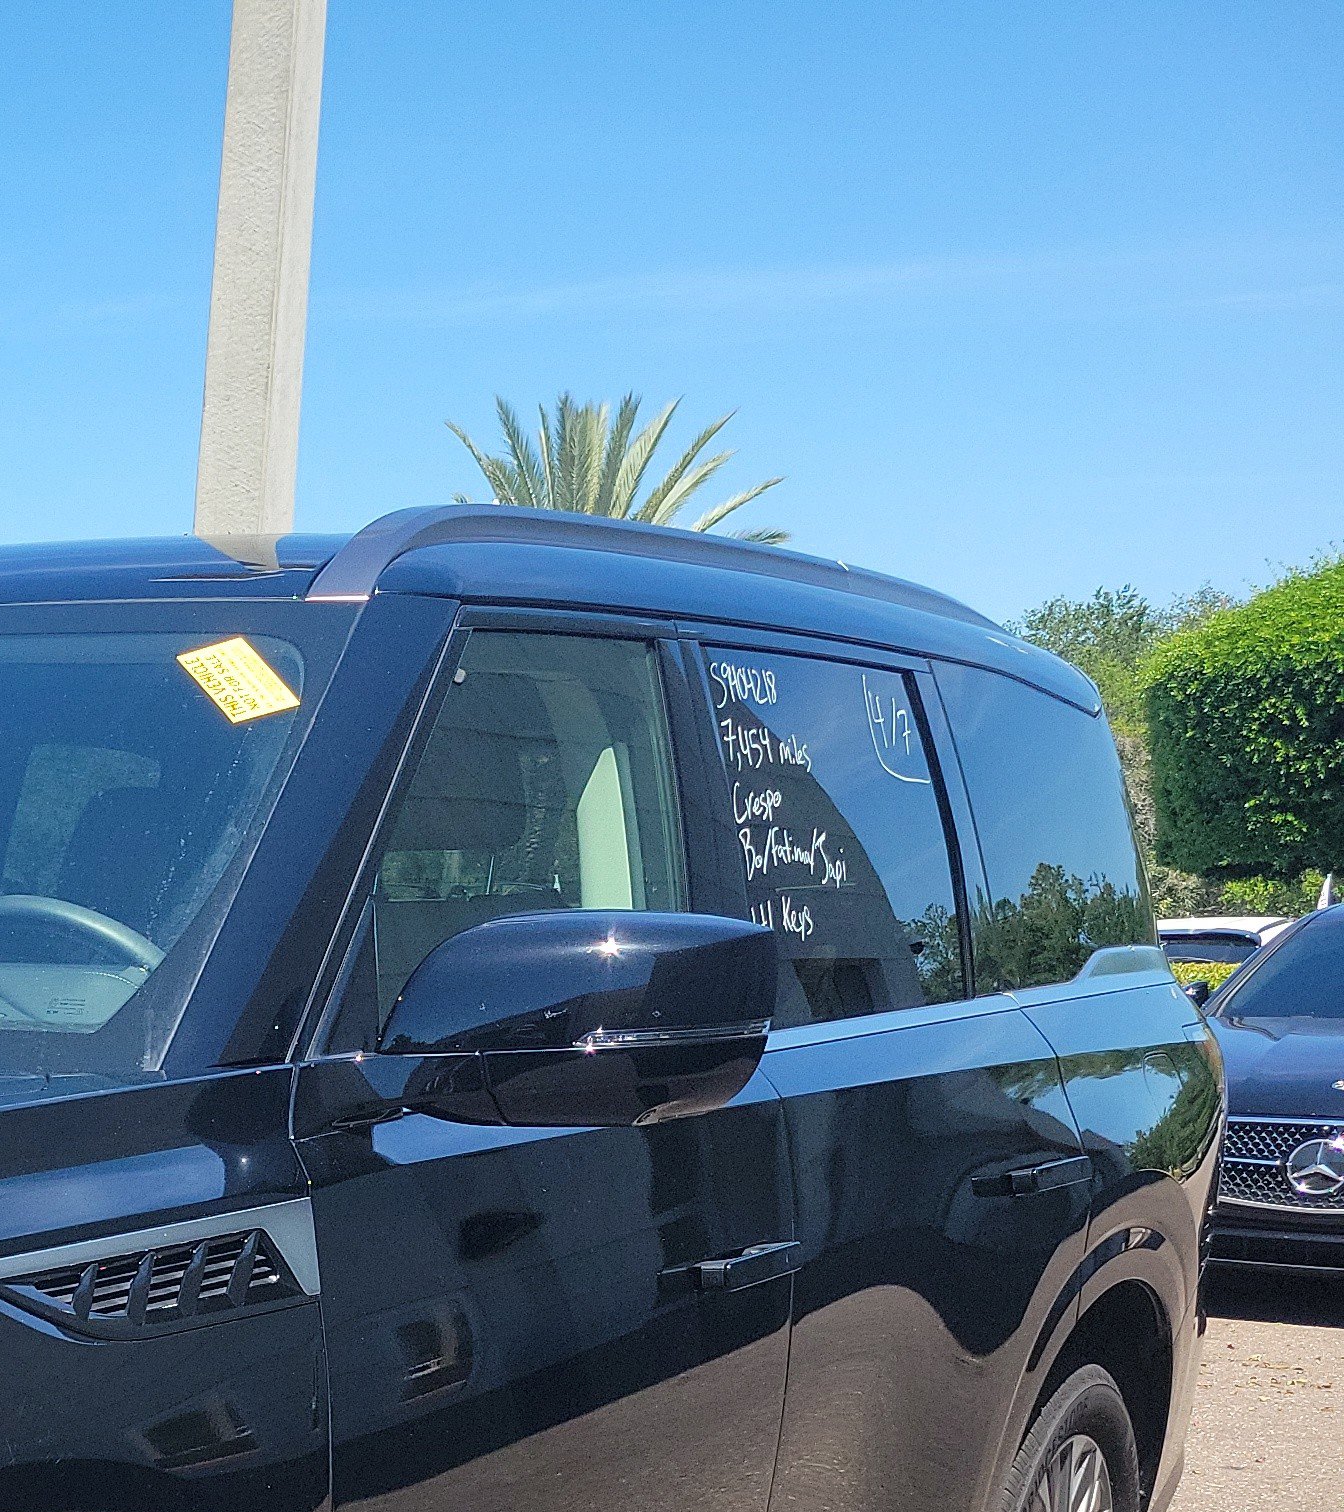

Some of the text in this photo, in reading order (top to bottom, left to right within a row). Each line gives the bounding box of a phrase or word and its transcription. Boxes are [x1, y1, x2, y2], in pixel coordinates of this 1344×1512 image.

[184, 656, 226, 696] VEHICLE
[205, 654, 261, 711] NOT FOR SALE
[218, 693, 247, 717] THIS
[867, 690, 911, 755] 4/7
[720, 717, 812, 773] 7,454 miles
[732, 781, 782, 825] Crespo
[781, 895, 814, 942] Keys
